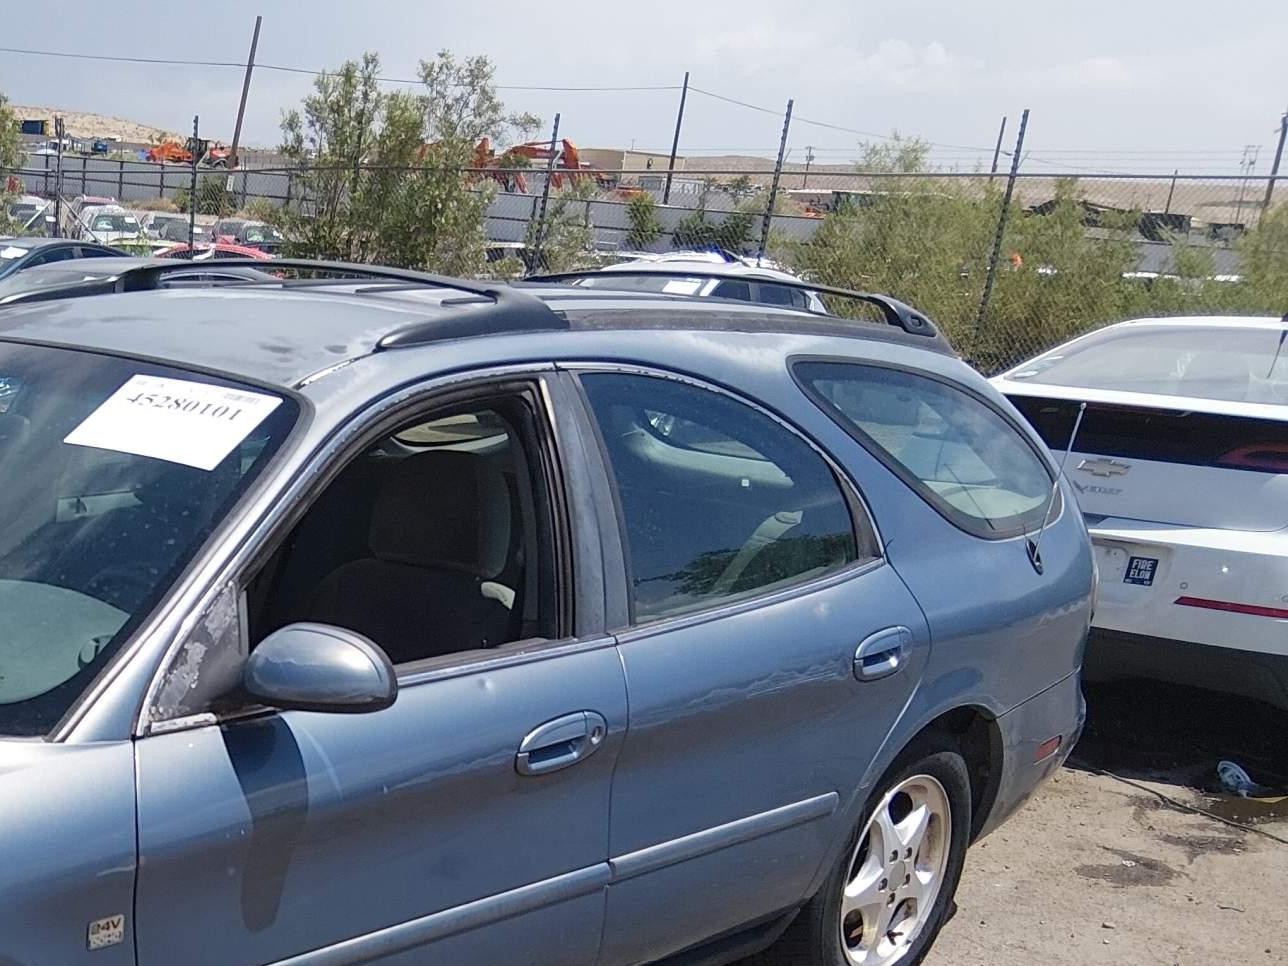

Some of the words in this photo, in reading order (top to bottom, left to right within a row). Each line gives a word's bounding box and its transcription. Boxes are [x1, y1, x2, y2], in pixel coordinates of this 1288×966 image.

[126, 393, 243, 421] 45280101
[1132, 559, 1154, 570] FIRE
[91, 917, 122, 935] 24V
